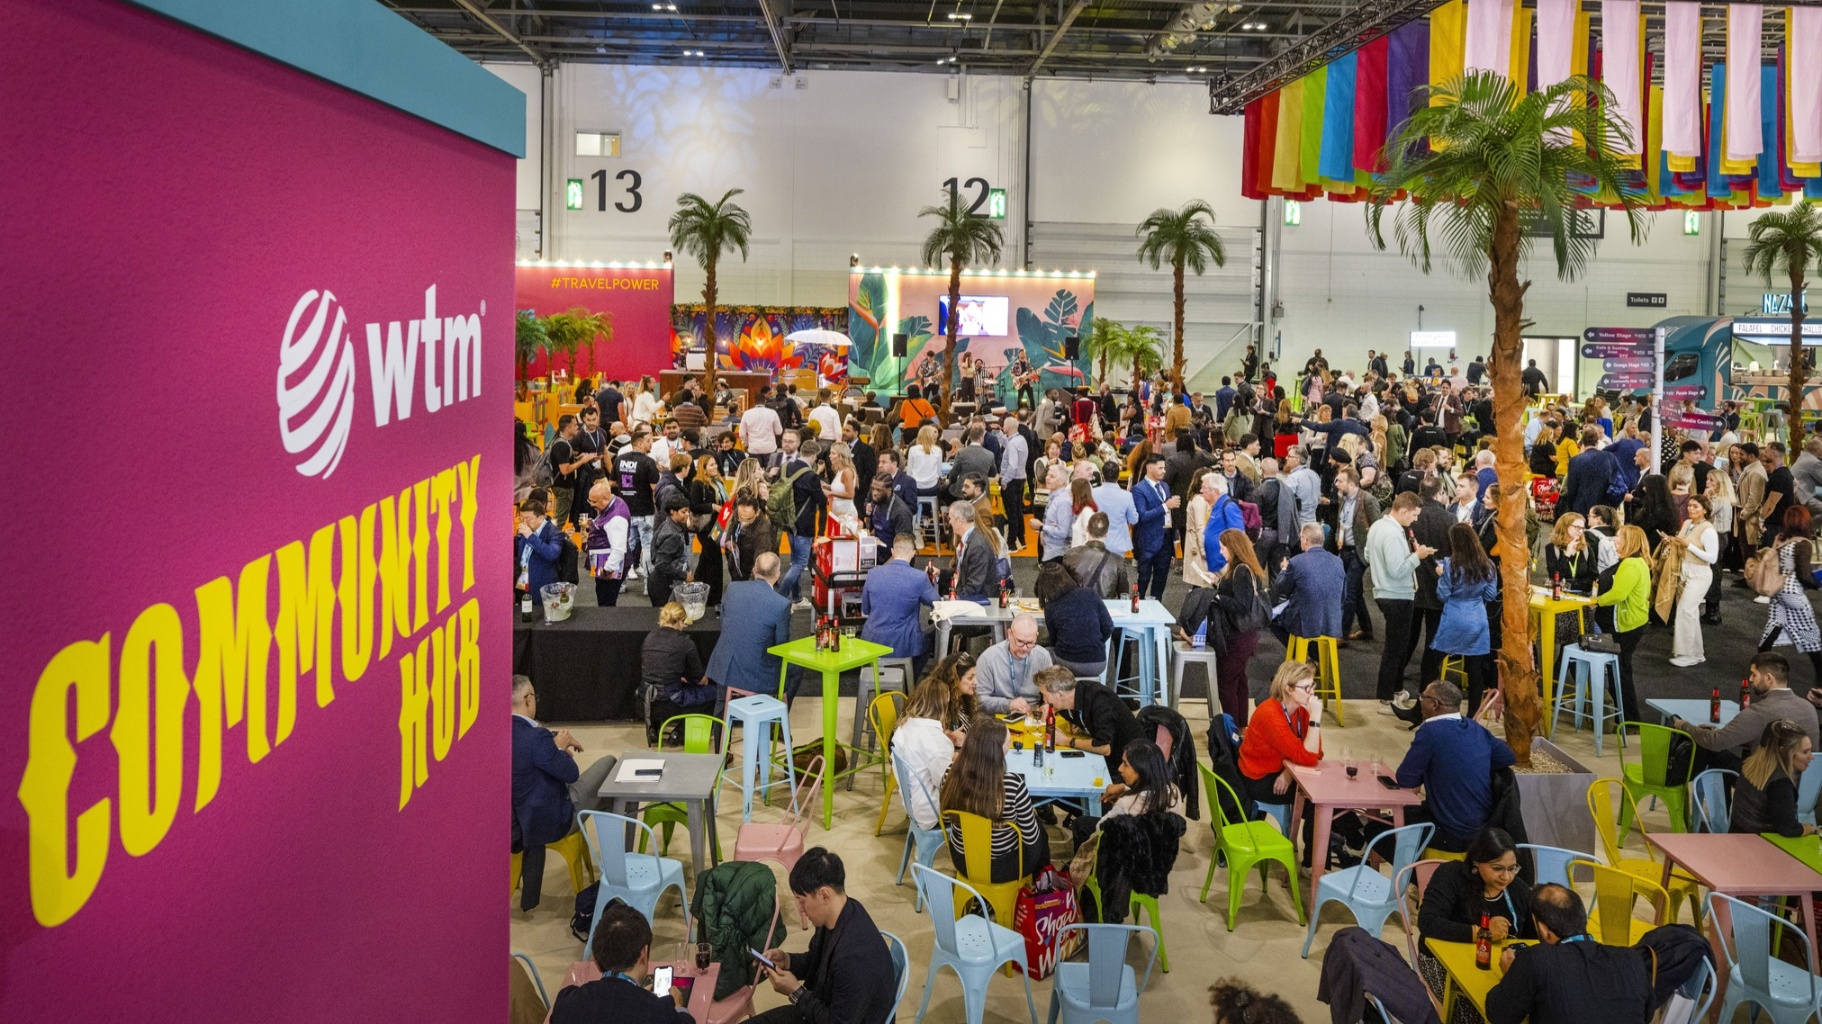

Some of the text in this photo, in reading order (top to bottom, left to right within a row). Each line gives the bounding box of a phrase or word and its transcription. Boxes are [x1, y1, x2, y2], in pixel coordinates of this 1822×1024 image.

[591, 169, 643, 213] 13
[943, 177, 990, 219] 12
[551, 276, 659, 290] #TRAVELPOWER
[1630, 296, 1650, 304] Toilets
[1738, 324, 1763, 333] FALAFEL
[1770, 325, 1792, 334] CHICKE
[365, 283, 482, 426] wtm
[1696, 418, 1715, 426] Centre
[17, 454, 481, 928] COMMUNITY
[398, 597, 480, 813] HUB
